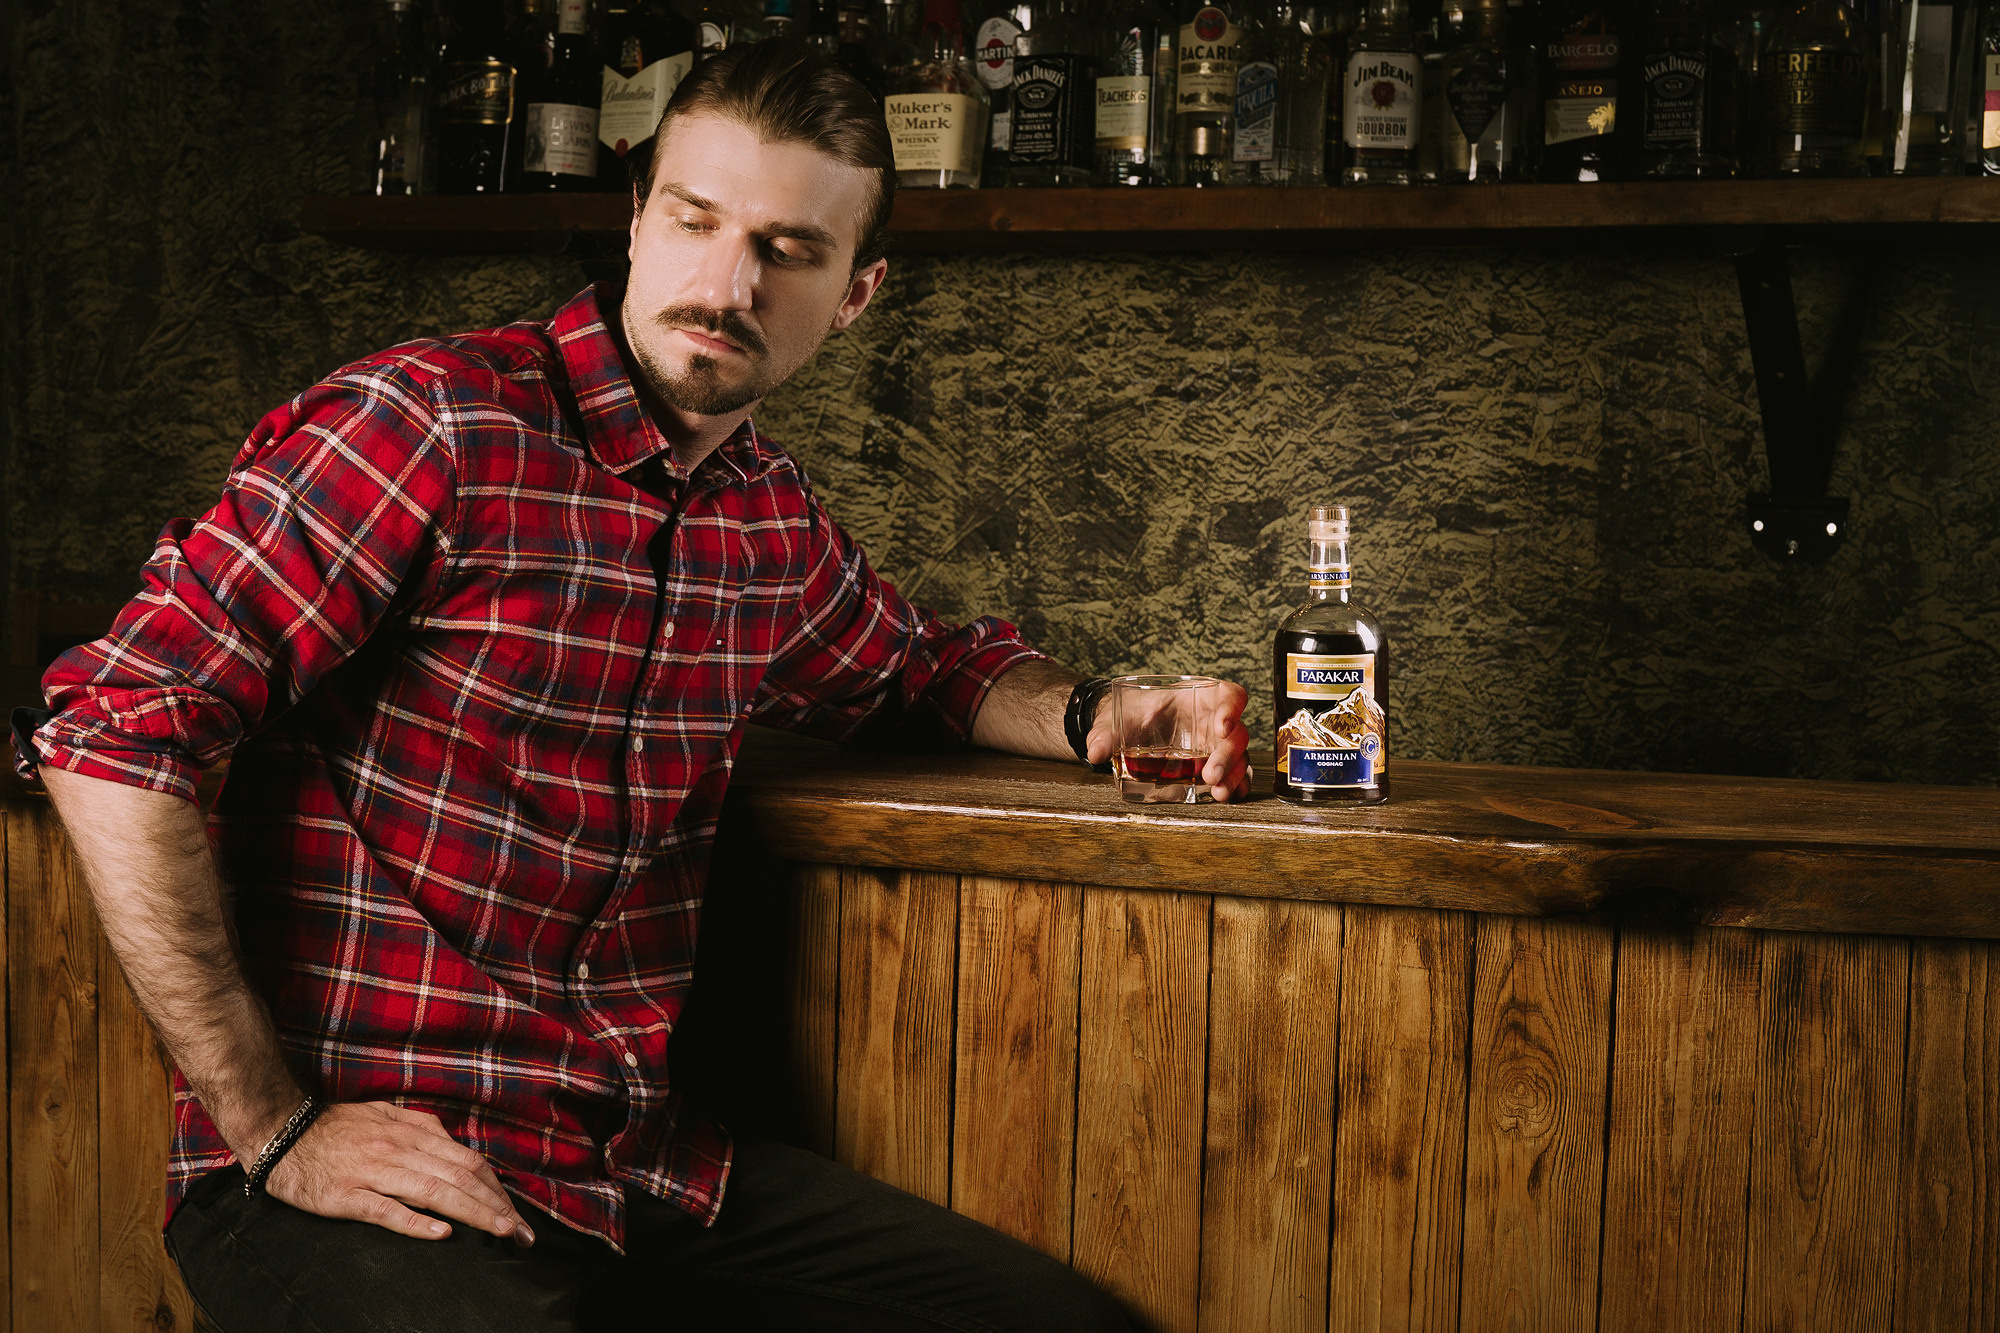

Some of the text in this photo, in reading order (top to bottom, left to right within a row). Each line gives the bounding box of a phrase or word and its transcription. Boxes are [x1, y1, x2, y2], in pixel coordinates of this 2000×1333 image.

[977, 46, 1015, 62] MARTIN
[1181, 44, 1235, 61] BACARD
[1547, 40, 1618, 57] BARCELÓ
[1354, 61, 1414, 88] JIM BEAM
[1644, 55, 1705, 81] JACK DANIEL'S
[1558, 84, 1603, 96] AÑEJO
[889, 102, 952, 115] Maker's
[904, 117, 952, 130] Mark
[1357, 122, 1407, 136] BOURBON
[1311, 572, 1348, 580] ARMENIAN
[1301, 670, 1360, 683] PARAKAR
[1303, 752, 1358, 761] ARMENIAN
[1317, 768, 1344, 781] XO
